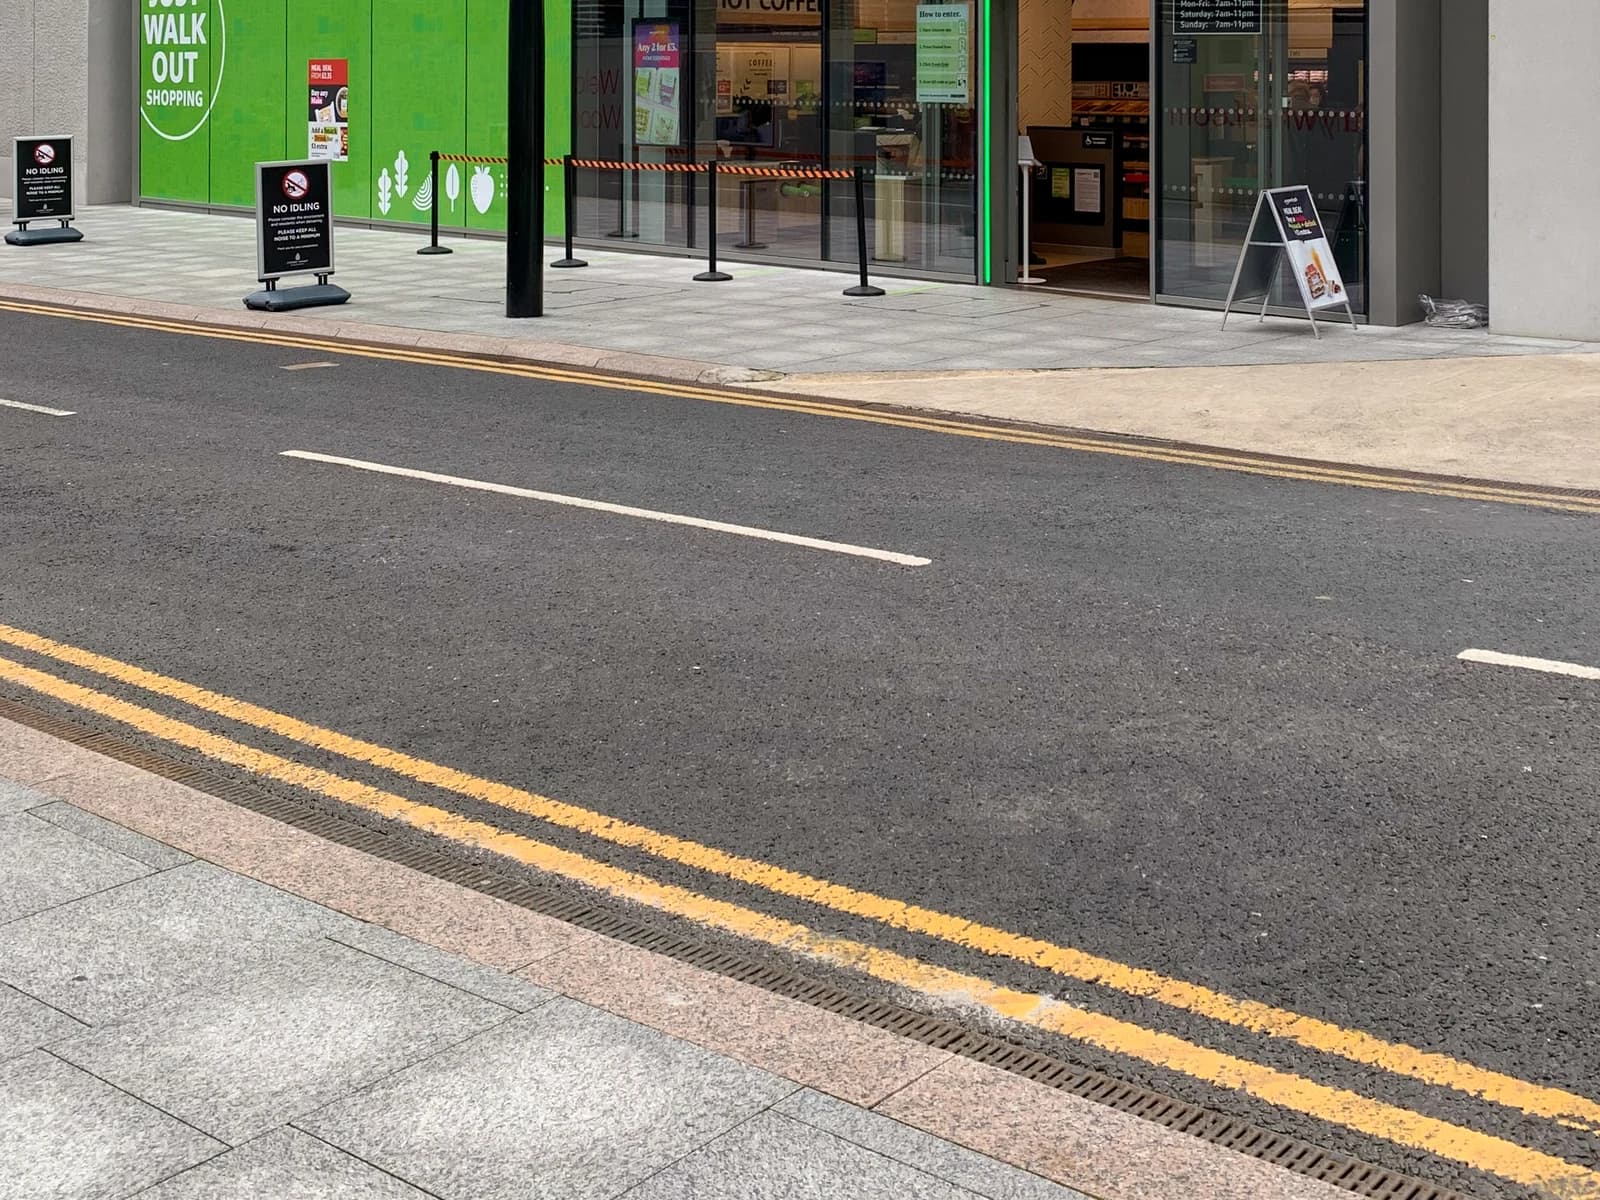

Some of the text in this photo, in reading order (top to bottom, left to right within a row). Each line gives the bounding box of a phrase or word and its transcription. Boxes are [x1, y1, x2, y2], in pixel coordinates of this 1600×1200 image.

[1180, 0, 1254, 8] Mon-Fri: 7am-11pm
[919, 10, 933, 18] How
[935, 10, 942, 18] to
[1180, 9, 1254, 20] Saturday: 7am-11pm
[143, 12, 207, 45] WALK
[1180, 20, 1254, 30] Sunday: 7am-11pm
[151, 50, 198, 84] OUT
[146, 88, 203, 108] SHOPPING
[273, 202, 320, 214] NO IDLING
